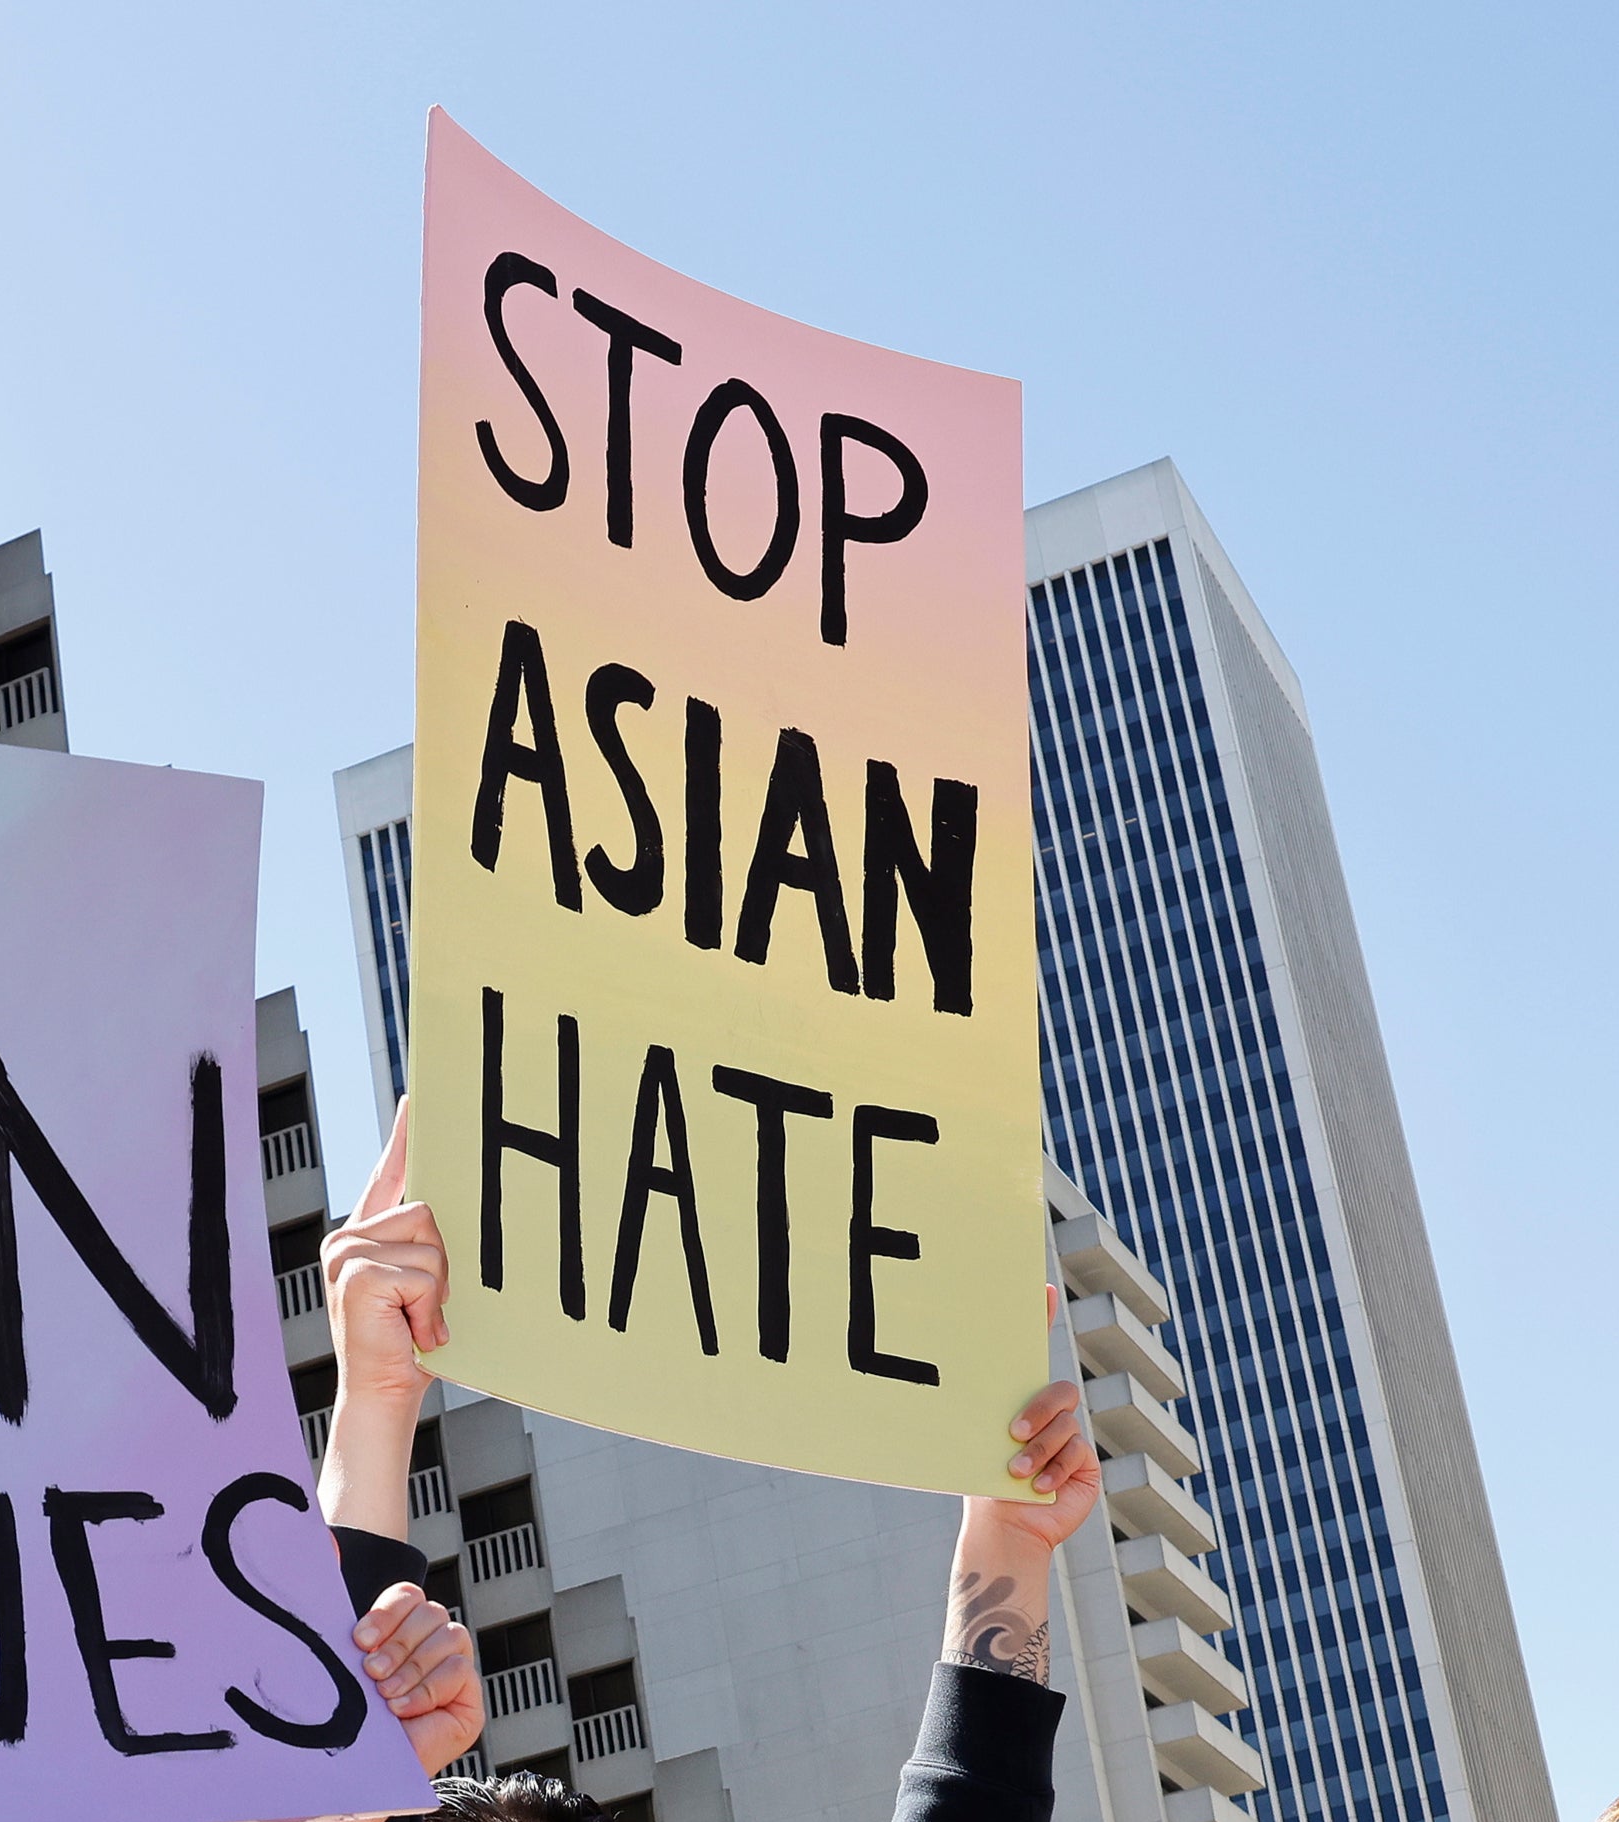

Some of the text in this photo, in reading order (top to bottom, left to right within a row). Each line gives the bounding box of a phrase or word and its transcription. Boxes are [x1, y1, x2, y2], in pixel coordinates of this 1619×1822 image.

[475, 250, 930, 650] STOP
[471, 617, 979, 1017] ASIAN
[481, 986, 940, 1386] HATE
